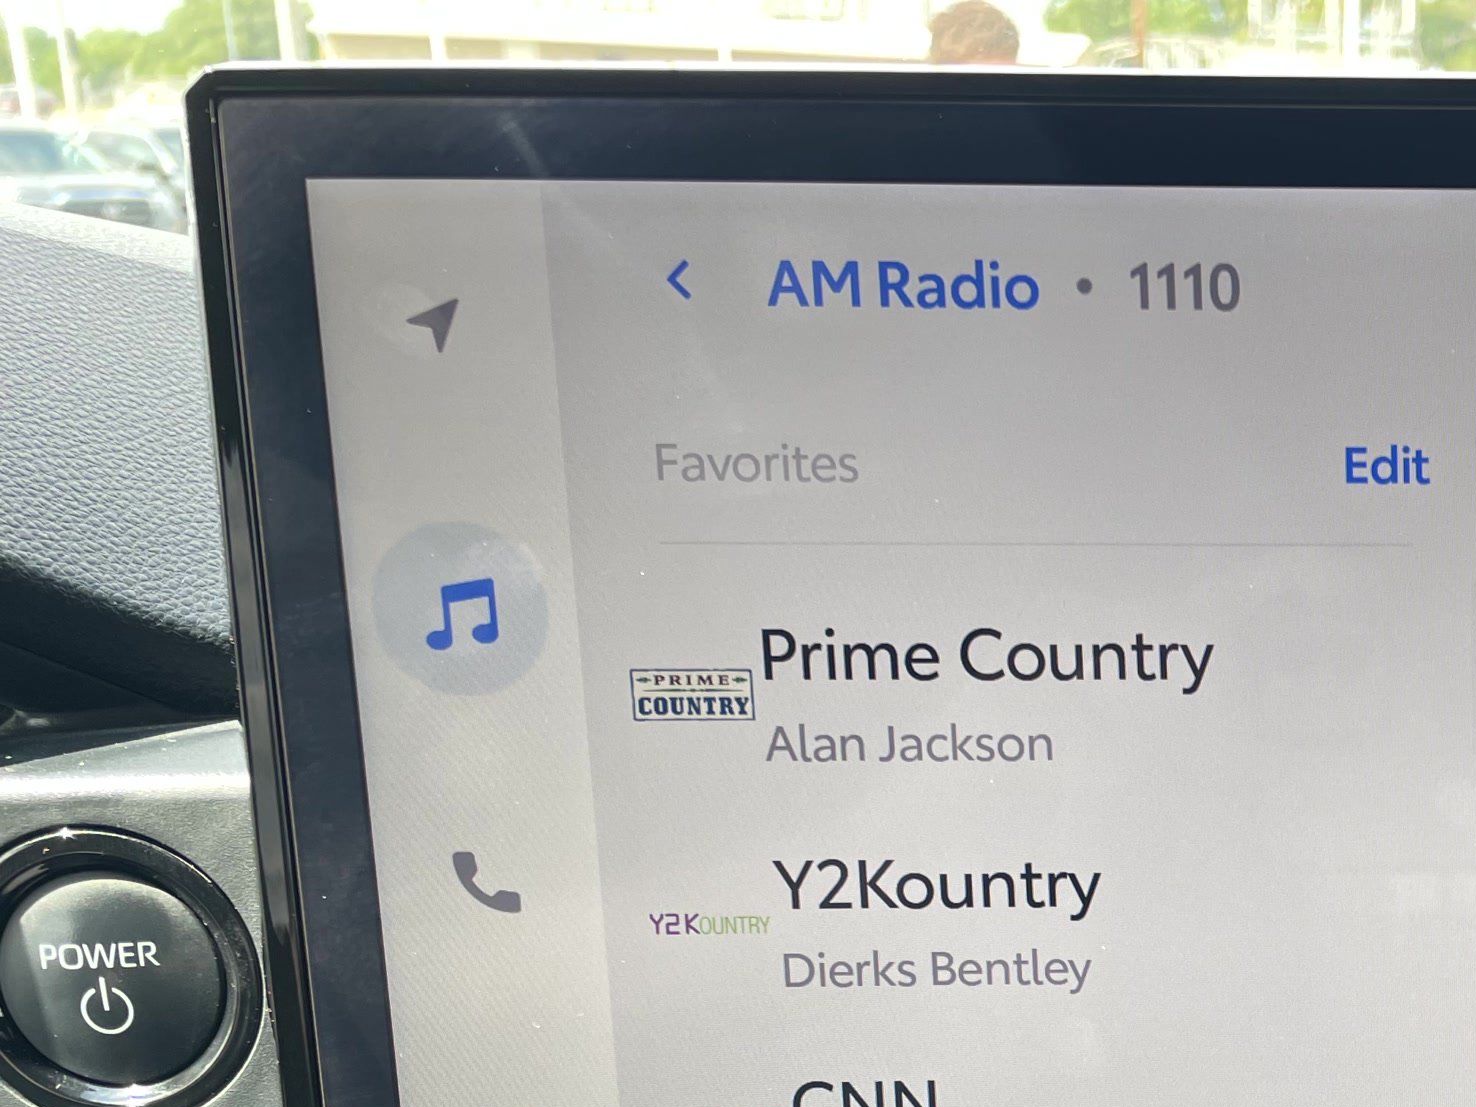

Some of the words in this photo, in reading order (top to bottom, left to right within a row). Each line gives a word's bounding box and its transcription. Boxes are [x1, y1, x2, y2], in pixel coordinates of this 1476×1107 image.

[768, 261, 862, 308] AM
[879, 260, 1040, 310] Radio
[1130, 262, 1241, 312] 1110
[654, 443, 860, 484] Favorites
[1344, 445, 1431, 486] Edit
[653, 675, 730, 686] PRIME
[761, 627, 940, 682] Prime
[959, 627, 1214, 696] Country
[638, 697, 749, 716] COUNTRY
[766, 723, 865, 763] Alan
[879, 723, 1054, 763] Jackson
[772, 858, 1102, 922] Y2Kountry
[38, 941, 161, 971] POWER
[783, 950, 918, 988] Dierks
[931, 948, 1092, 995] Bentley
